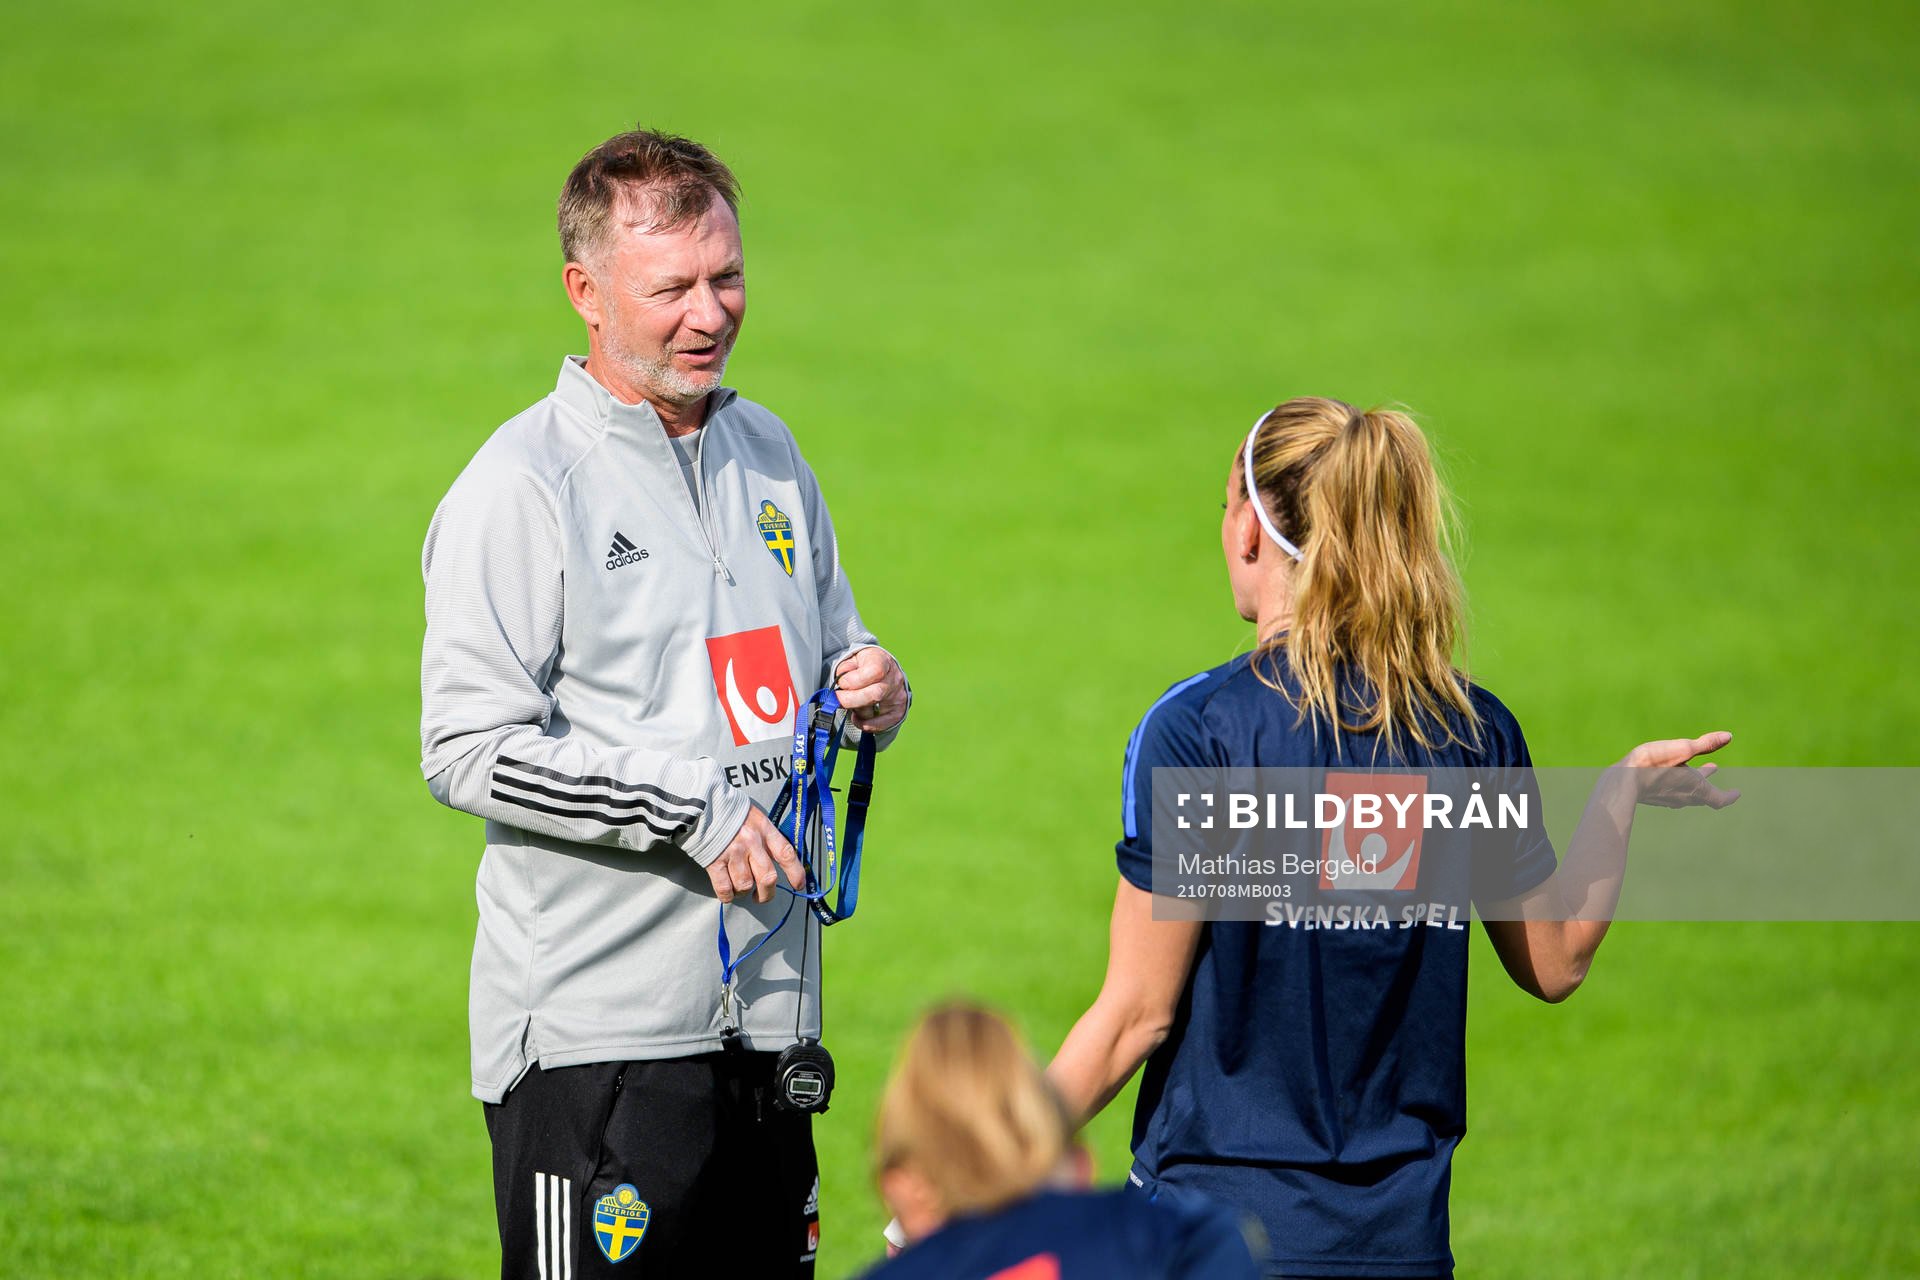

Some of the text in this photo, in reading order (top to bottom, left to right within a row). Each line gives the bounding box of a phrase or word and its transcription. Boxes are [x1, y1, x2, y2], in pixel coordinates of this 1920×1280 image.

[763, 521, 788, 530] SVERIGE
[605, 548, 650, 571] adidas
[795, 734, 806, 755] SAS
[724, 755, 789, 788] ENSK
[1265, 901, 1465, 931] SVENSKA SPEL
[604, 1205, 642, 1218] SVERIGE
